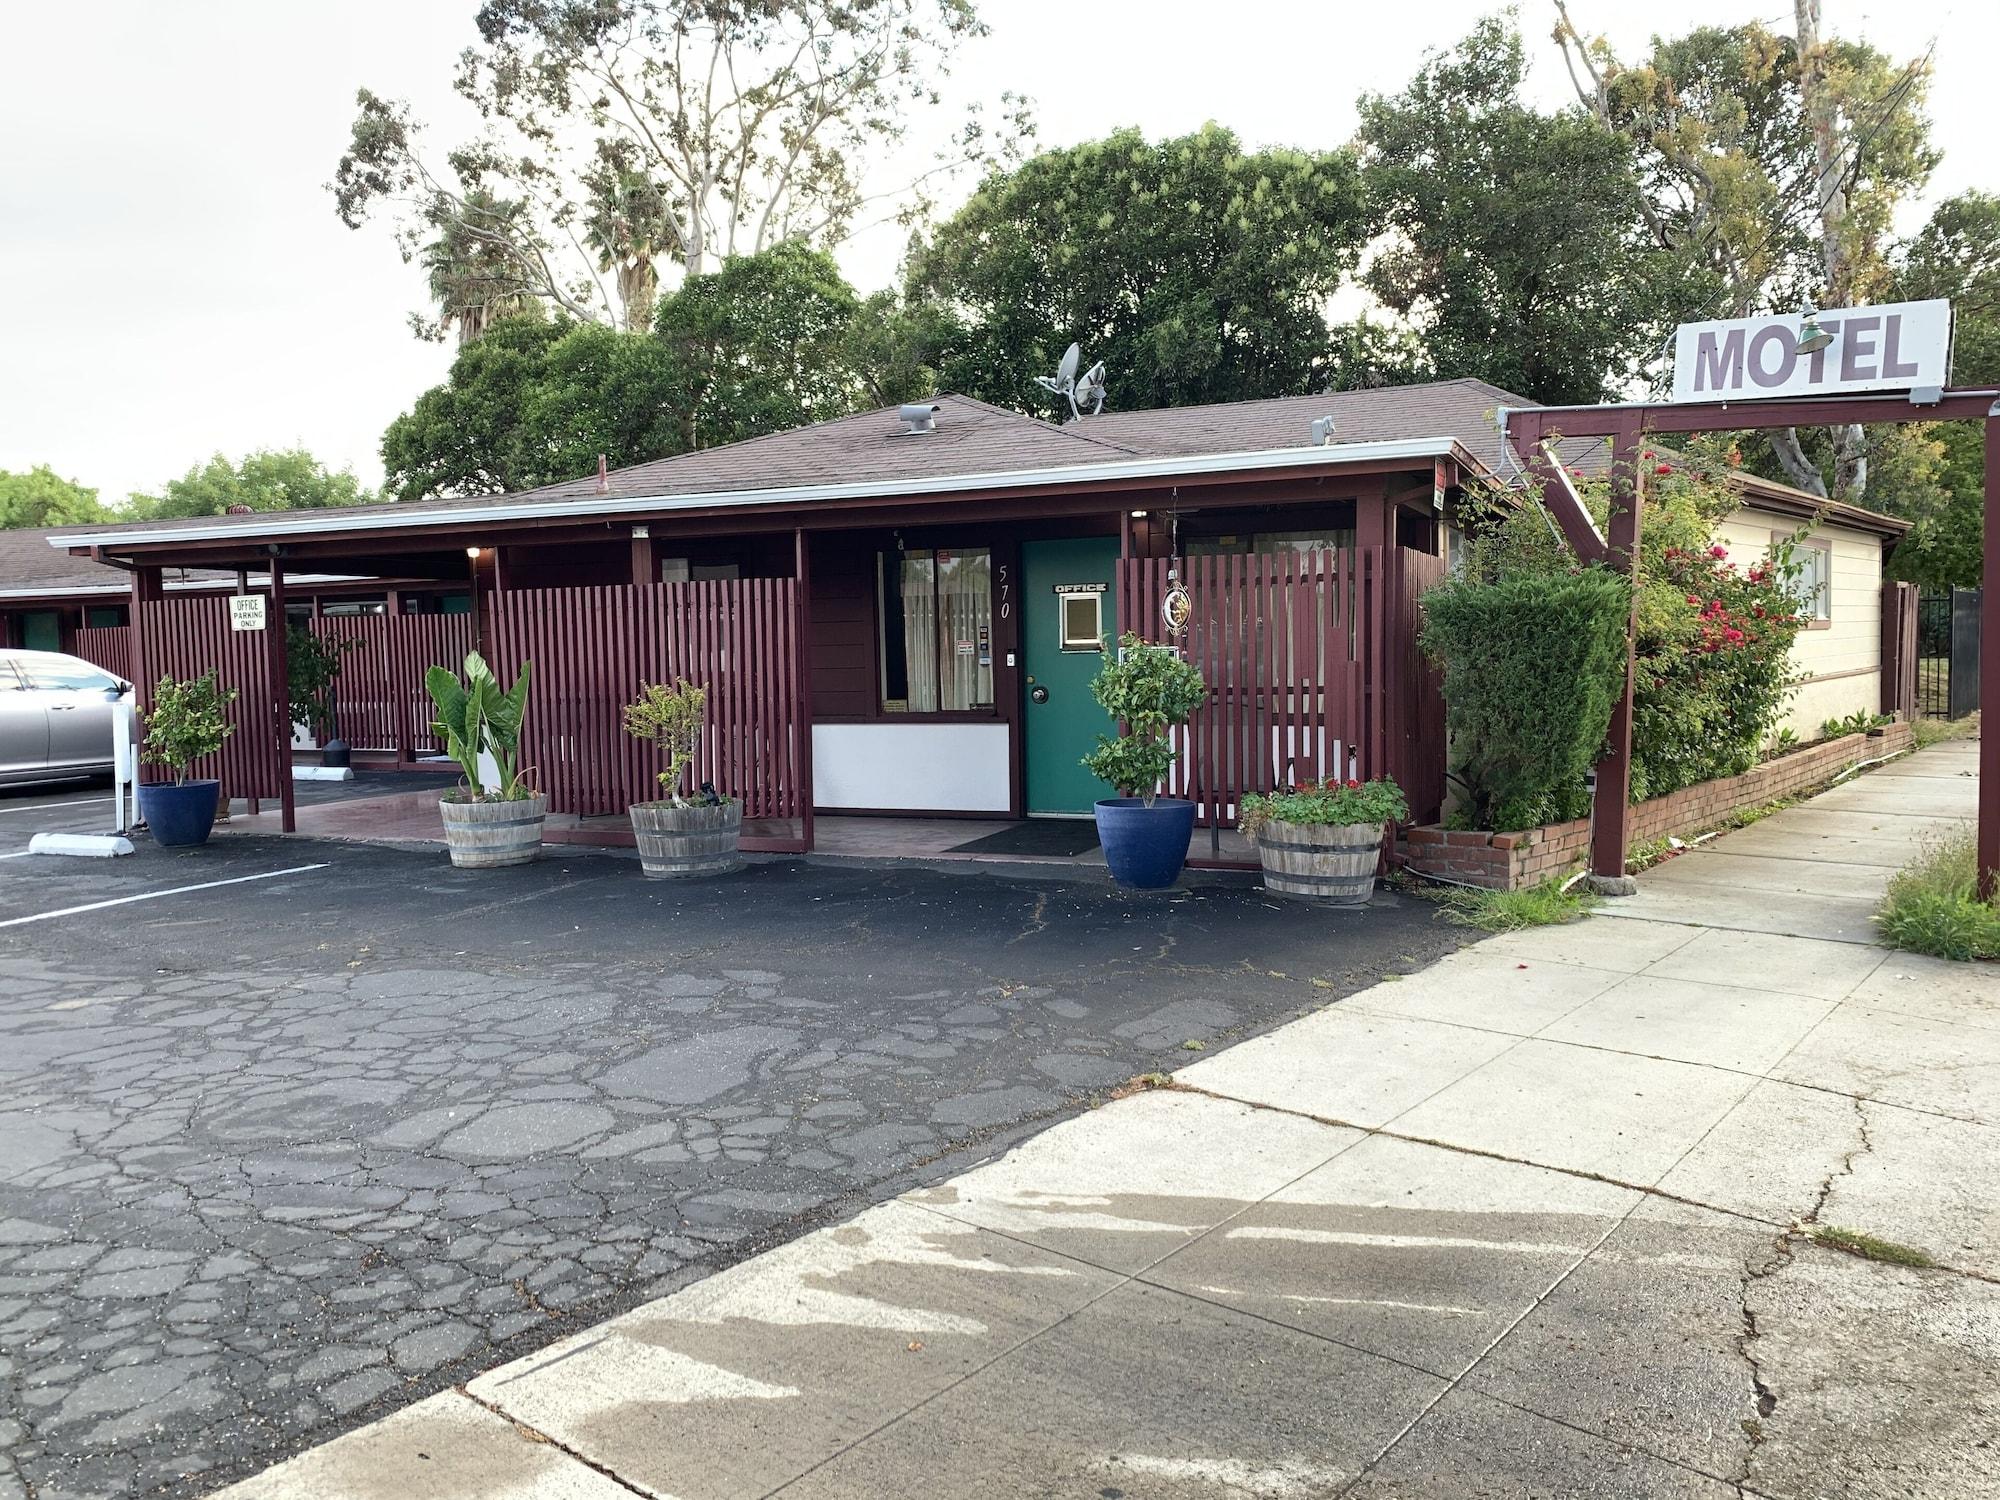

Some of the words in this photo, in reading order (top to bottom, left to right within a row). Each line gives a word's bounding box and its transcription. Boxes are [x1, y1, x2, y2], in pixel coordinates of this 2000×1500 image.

[1694, 315, 1919, 392] MOTEL
[999, 564, 1010, 619] 570
[1055, 583, 1107, 593] OFFICE
[236, 600, 258, 610] OFFICE
[233, 611, 262, 619] PARKING
